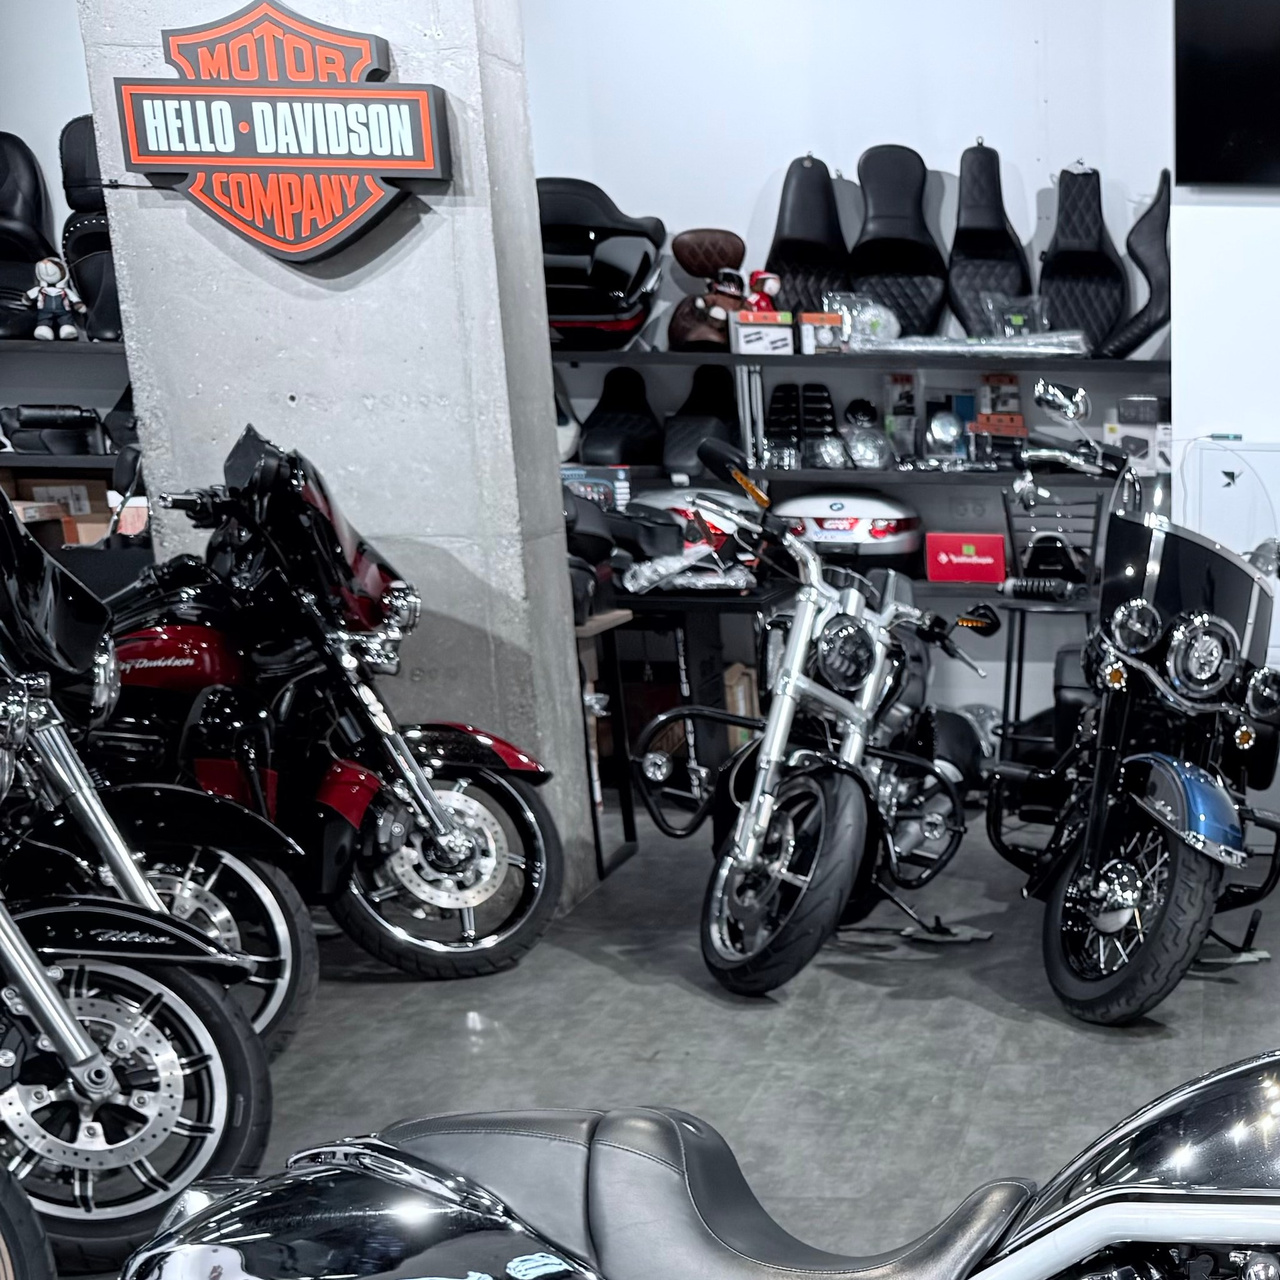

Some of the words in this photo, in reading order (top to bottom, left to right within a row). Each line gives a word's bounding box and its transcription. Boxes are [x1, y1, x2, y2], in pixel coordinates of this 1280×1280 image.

[197, 20, 347, 83] MOTOR
[142, 99, 236, 153] HELLO
[251, 101, 414, 157] DAVIDSON
[211, 172, 360, 241] COMPANY
